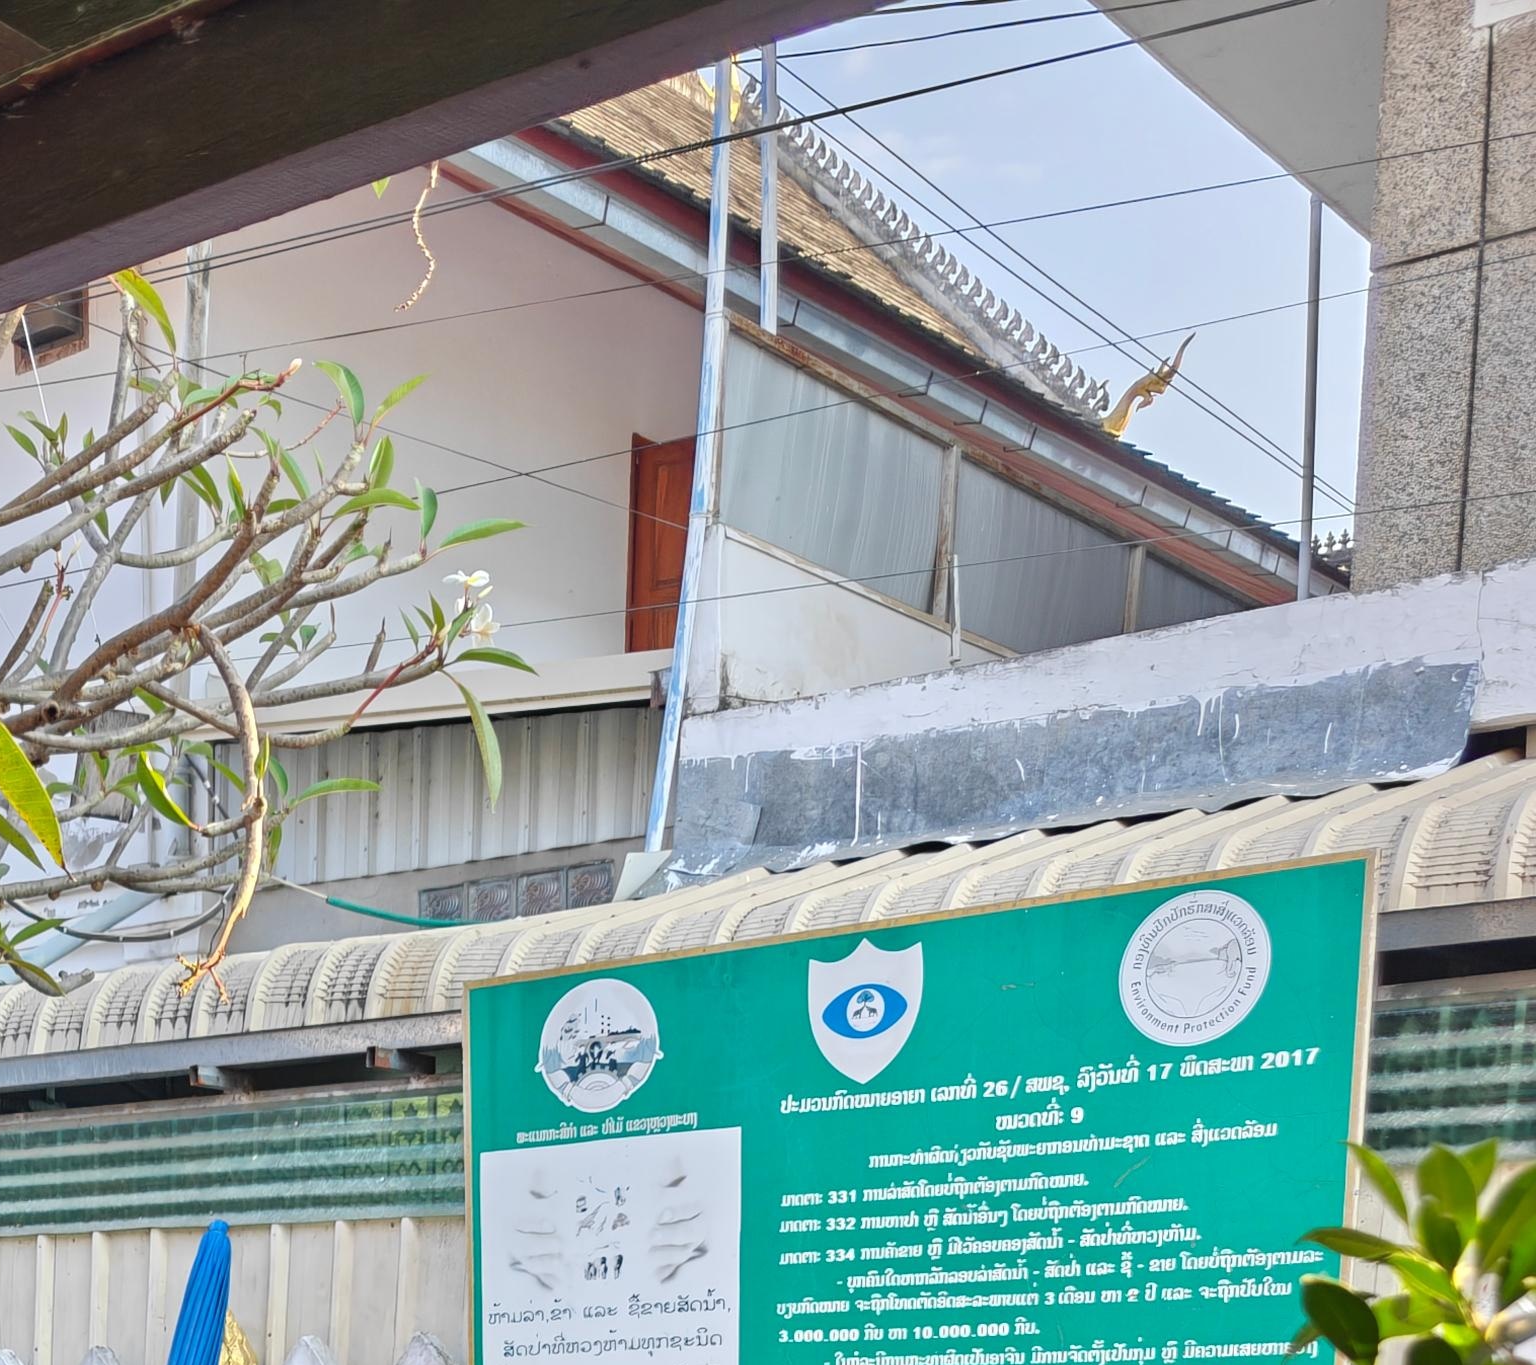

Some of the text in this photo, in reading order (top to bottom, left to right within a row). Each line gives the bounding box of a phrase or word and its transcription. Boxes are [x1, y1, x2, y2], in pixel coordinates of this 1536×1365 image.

[1131, 966, 1257, 1034] Environment Protection Fund
[983, 1080, 1008, 1098] 26
[1147, 1063, 1173, 1081] 17
[1260, 1047, 1321, 1070] 2017
[1070, 1106, 1084, 1124] 9
[828, 1189, 856, 1204] 331
[826, 1217, 856, 1231] 332
[825, 1248, 855, 1262] 334
[1044, 1291, 1055, 1305] 3
[778, 1328, 860, 1342] 3.000.000
[913, 1323, 1010, 1340] 10.000.000
